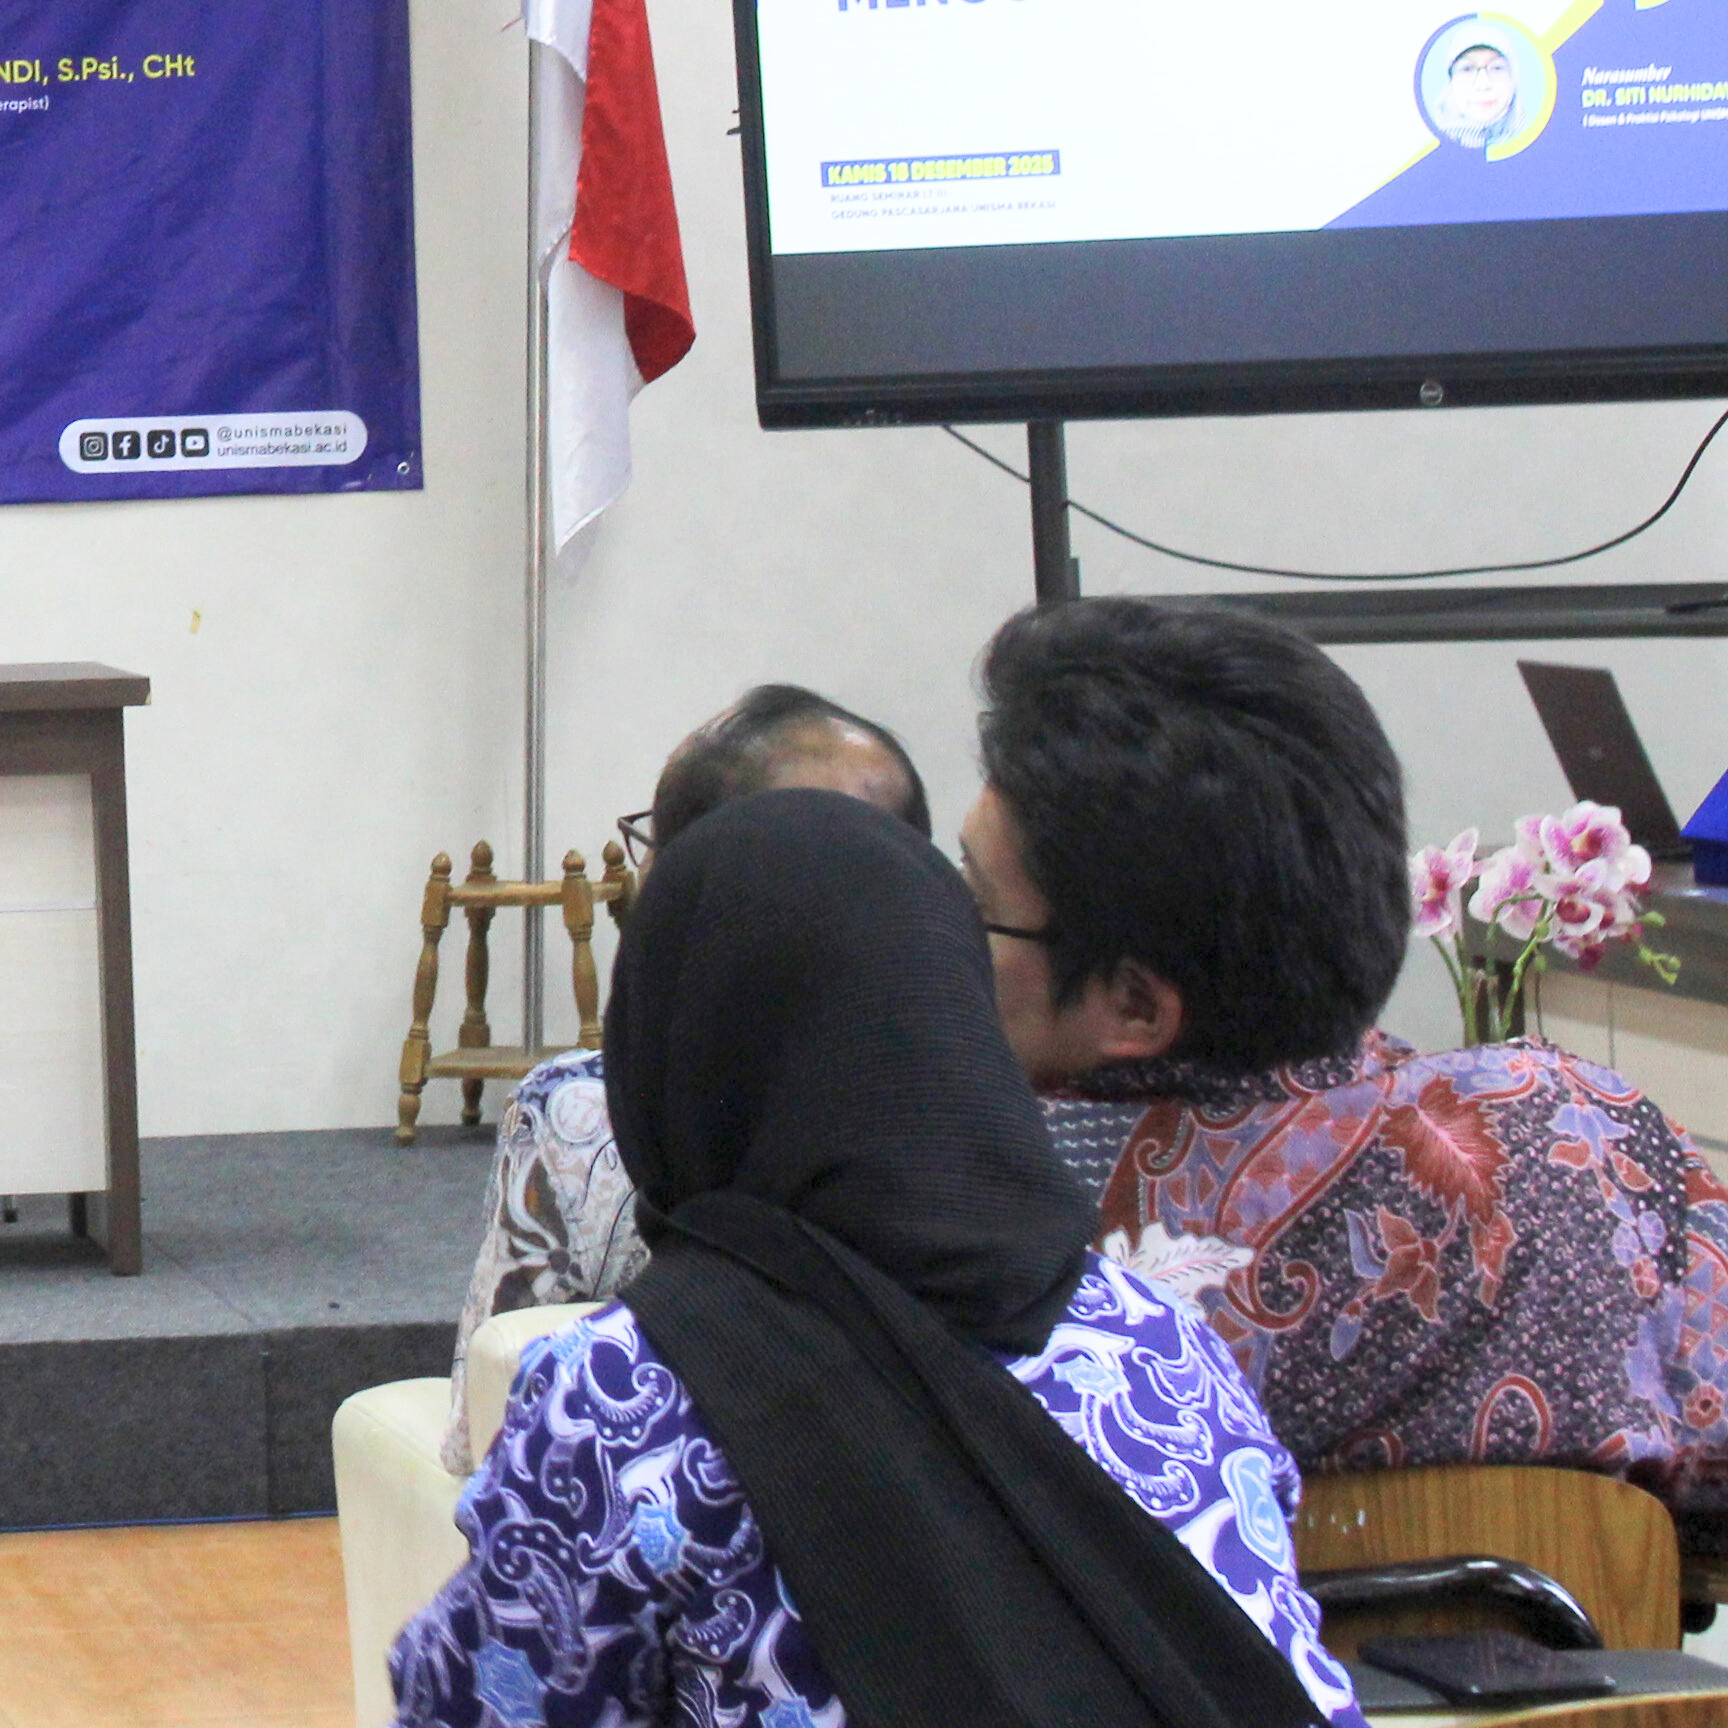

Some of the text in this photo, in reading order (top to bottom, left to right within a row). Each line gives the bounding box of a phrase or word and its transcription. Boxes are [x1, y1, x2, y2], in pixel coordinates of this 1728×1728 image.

[57, 59, 134, 82] S.Psi.,
[143, 55, 195, 79] CHt
[1582, 88, 1612, 107] DR.
[1615, 87, 1646, 106] SITI
[828, 163, 887, 185] KAMIS
[911, 157, 1006, 181] DESEMBER
[1008, 154, 1054, 175] 2025
[217, 423, 347, 441] @unismabekasi
[217, 441, 347, 457] unismabekasi.ac.id
